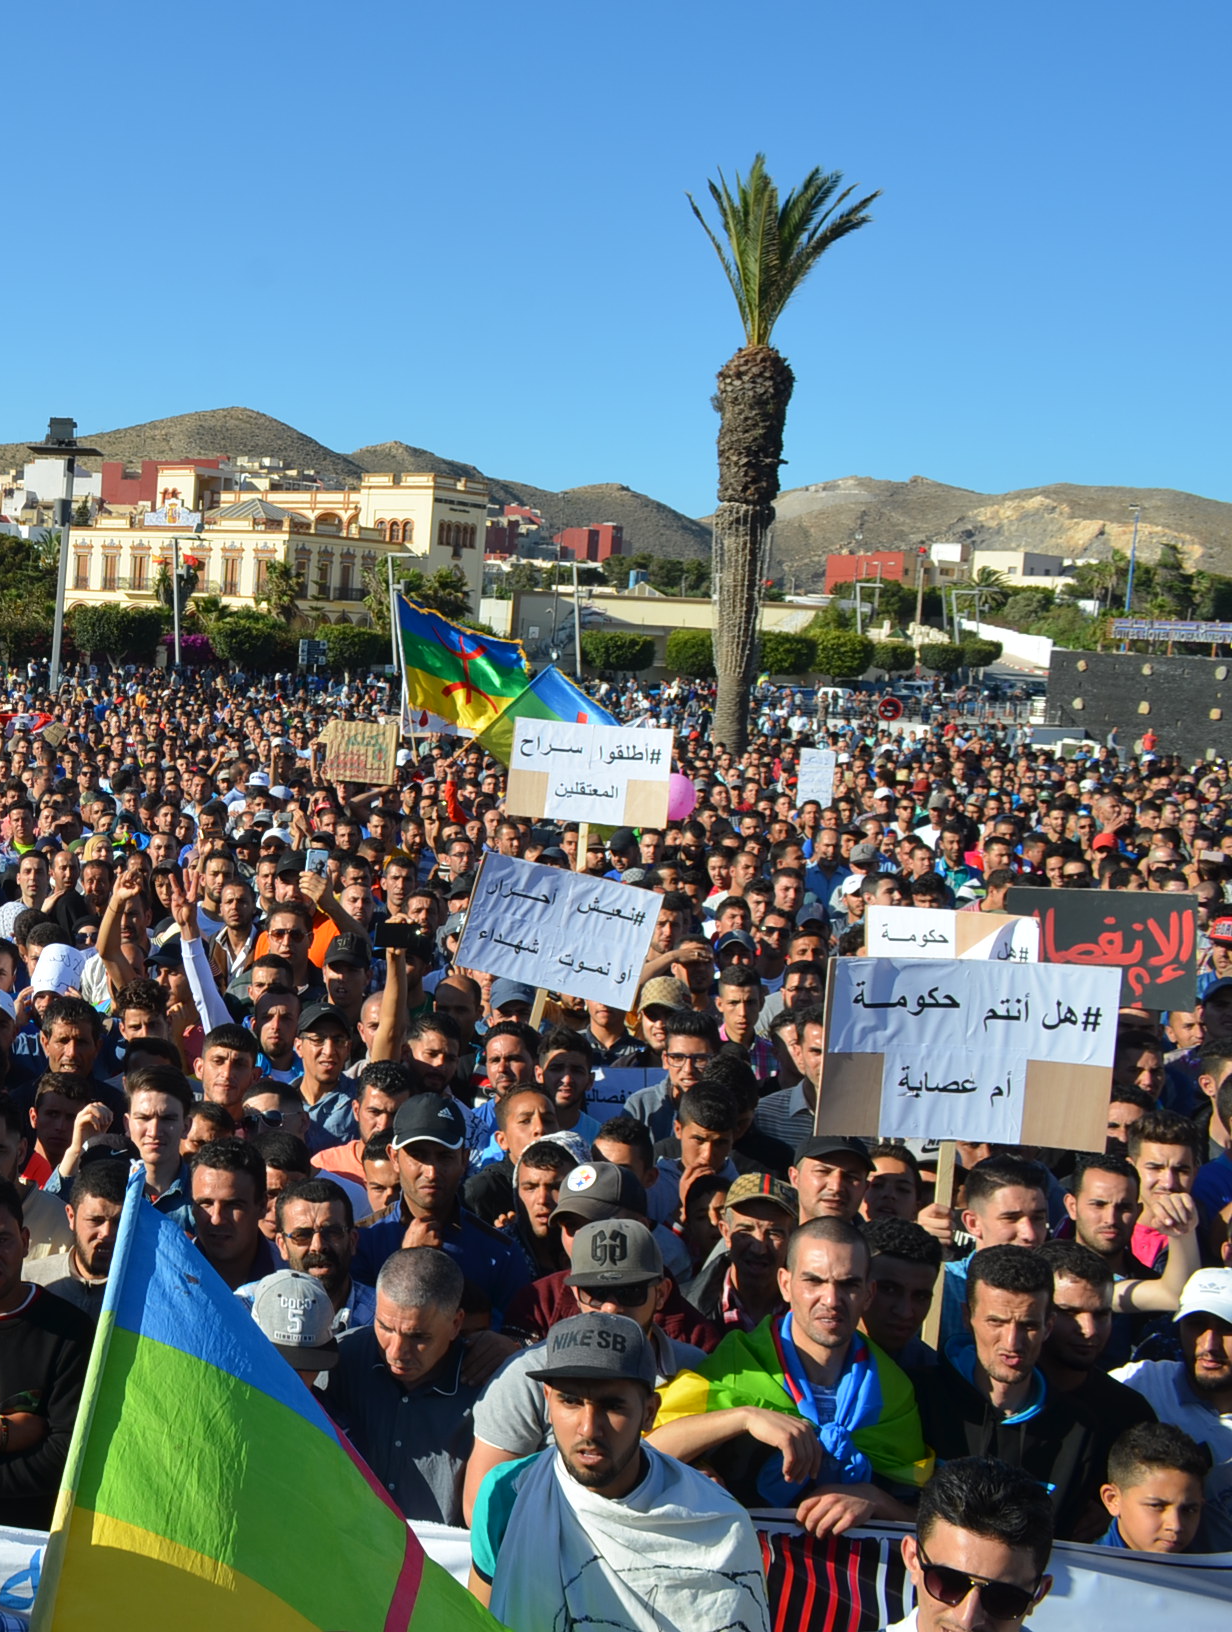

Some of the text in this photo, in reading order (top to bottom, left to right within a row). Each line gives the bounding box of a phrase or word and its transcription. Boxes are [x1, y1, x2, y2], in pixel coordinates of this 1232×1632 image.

[519, 735, 584, 757] سراح
[554, 781, 619, 800] المعتقلين
[485, 878, 646, 927] #نعيش أحرار
[880, 923, 949, 948] حكومة
[478, 928, 633, 985] أو نموت شهداء
[852, 980, 1103, 1033] #هل أنتم حكومة
[897, 1064, 1013, 1108] أم عصابة
[280, 1296, 313, 1310] COCO
[287, 1309, 305, 1333] 5
[552, 1329, 627, 1354] NIKE SB
